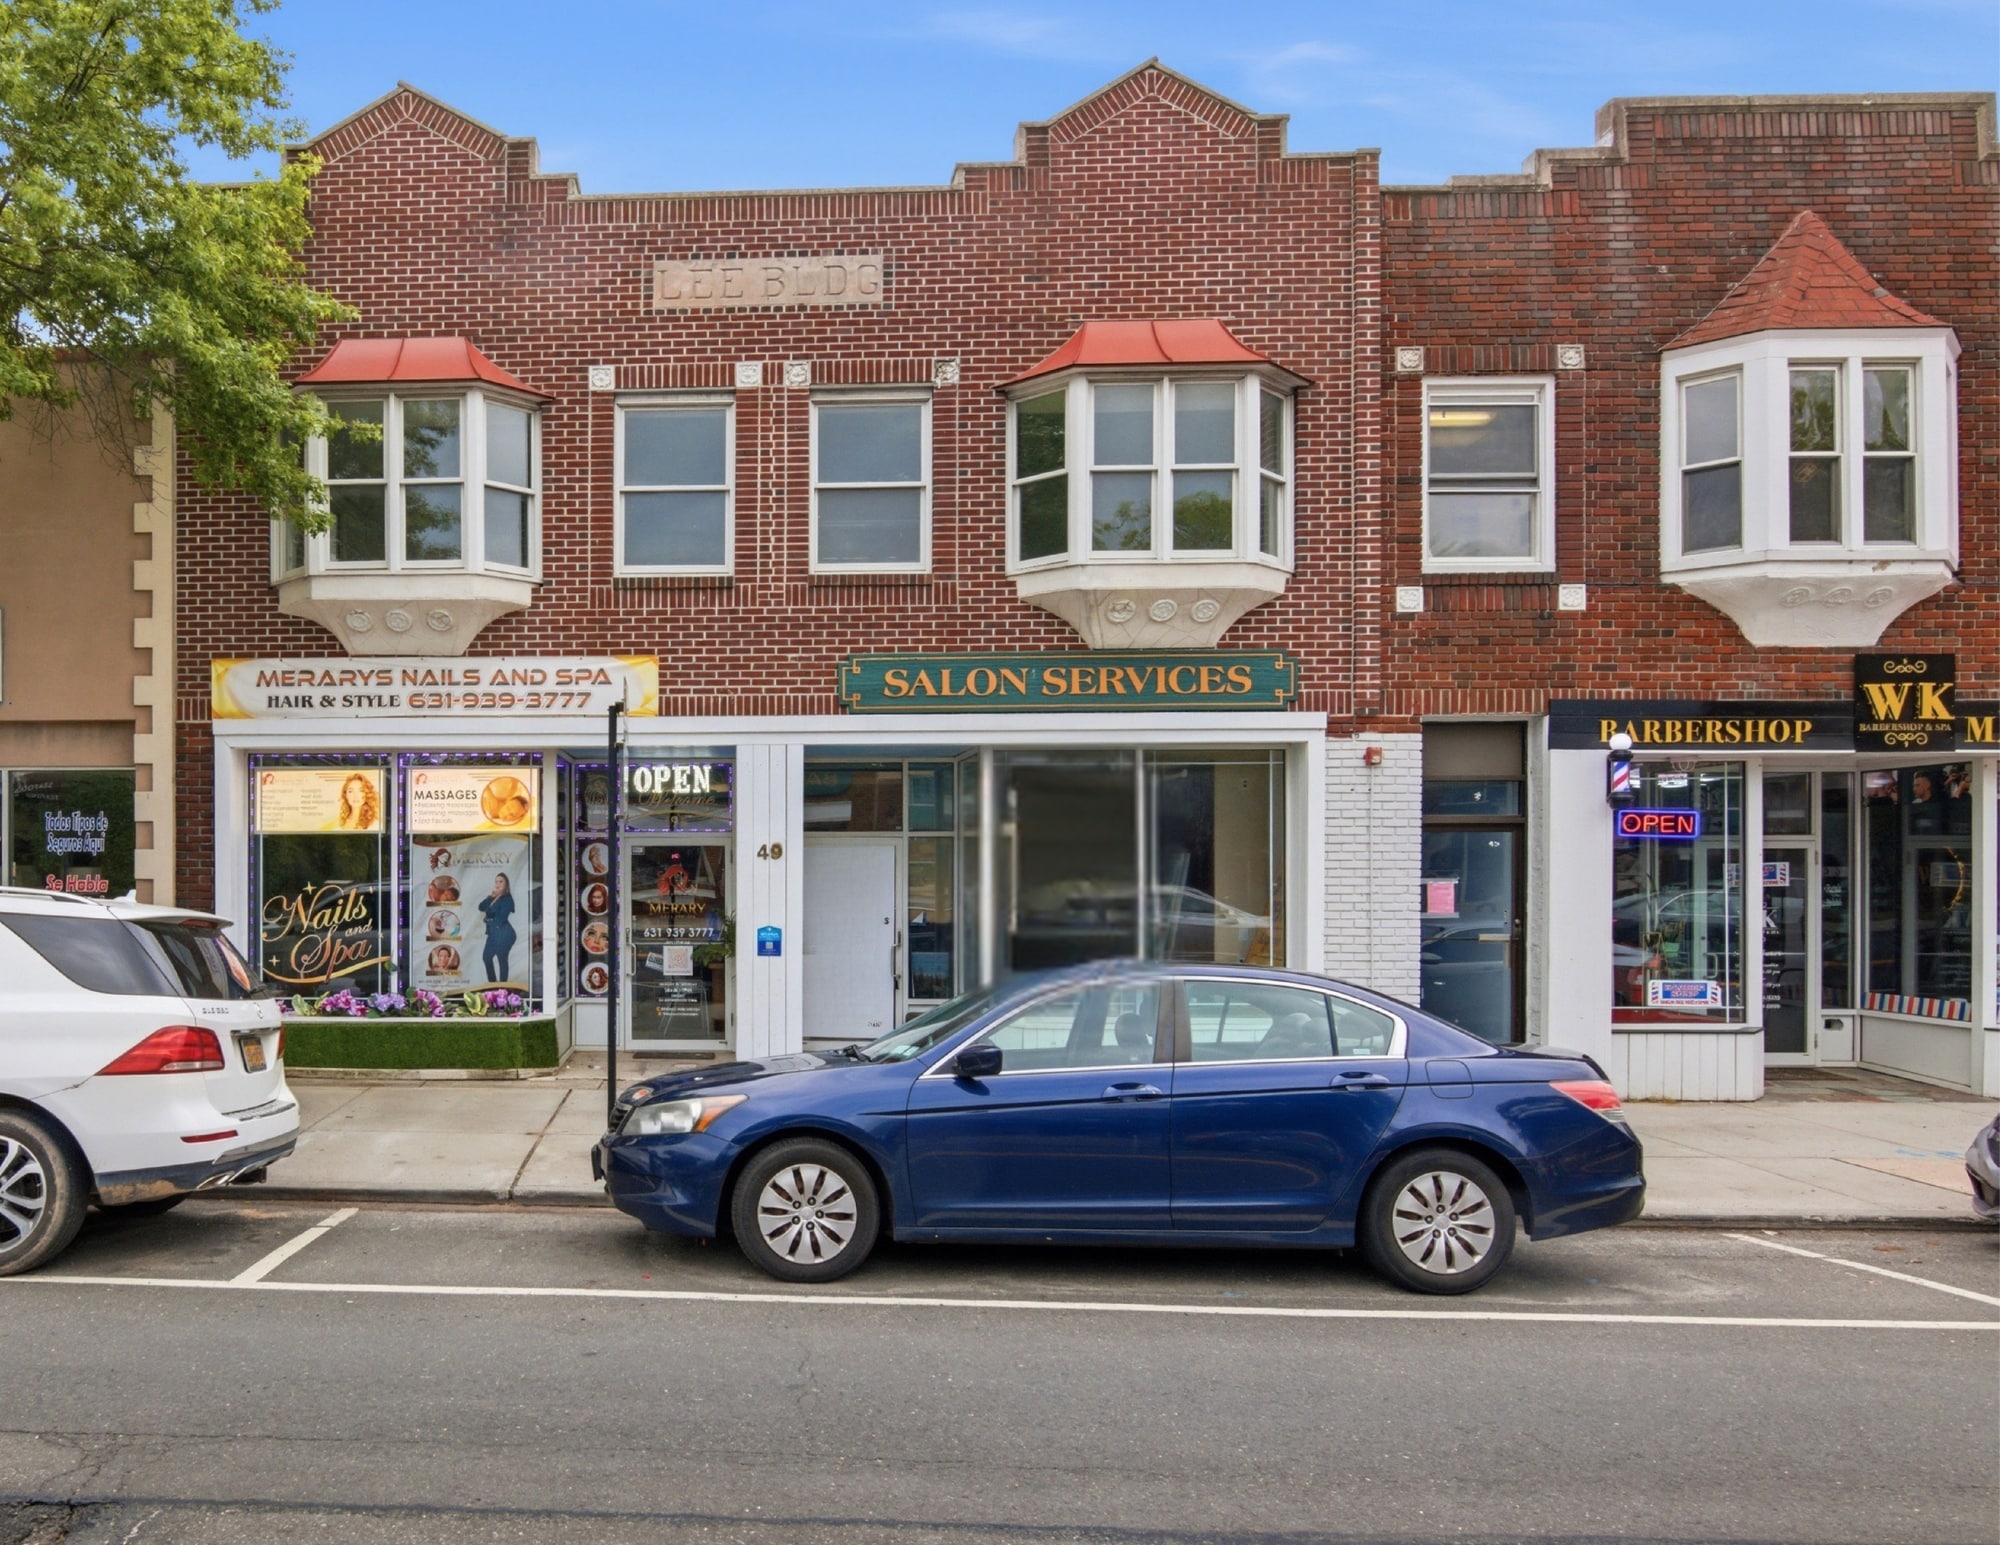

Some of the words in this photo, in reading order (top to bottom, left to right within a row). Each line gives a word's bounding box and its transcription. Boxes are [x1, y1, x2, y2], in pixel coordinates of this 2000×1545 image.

[658, 268, 743, 300] LEE
[761, 264, 878, 298] BLDG
[256, 669, 394, 688] MERARYS
[401, 669, 482, 688] NAILS
[489, 668, 548, 687] AND
[555, 667, 613, 687] SPA
[883, 668, 1031, 700] SALON
[1042, 664, 1252, 697] SERVICES
[267, 694, 314, 709] HAIR
[320, 694, 336, 708] &
[342, 694, 401, 709] STYLE
[407, 691, 593, 710] 631-939-3777
[1863, 682, 1955, 721] WK
[1599, 718, 1813, 746] BARBERSHOP
[1964, 717, 2000, 743] M
[633, 765, 712, 794] OPEN
[414, 790, 478, 801] MASSAGES
[96, 811, 109, 832] de
[1622, 814, 1694, 834] OPEN
[47, 832, 82, 856] Seguros
[46, 873, 64, 892] Se
[66, 874, 109, 893] Habla
[261, 884, 368, 942] Nails
[649, 902, 706, 914] MERARY
[345, 918, 374, 937] and
[644, 928, 662, 938] 631
[666, 928, 686, 938] 939
[688, 928, 714, 938] 3777
[291, 924, 372, 984] Spa
